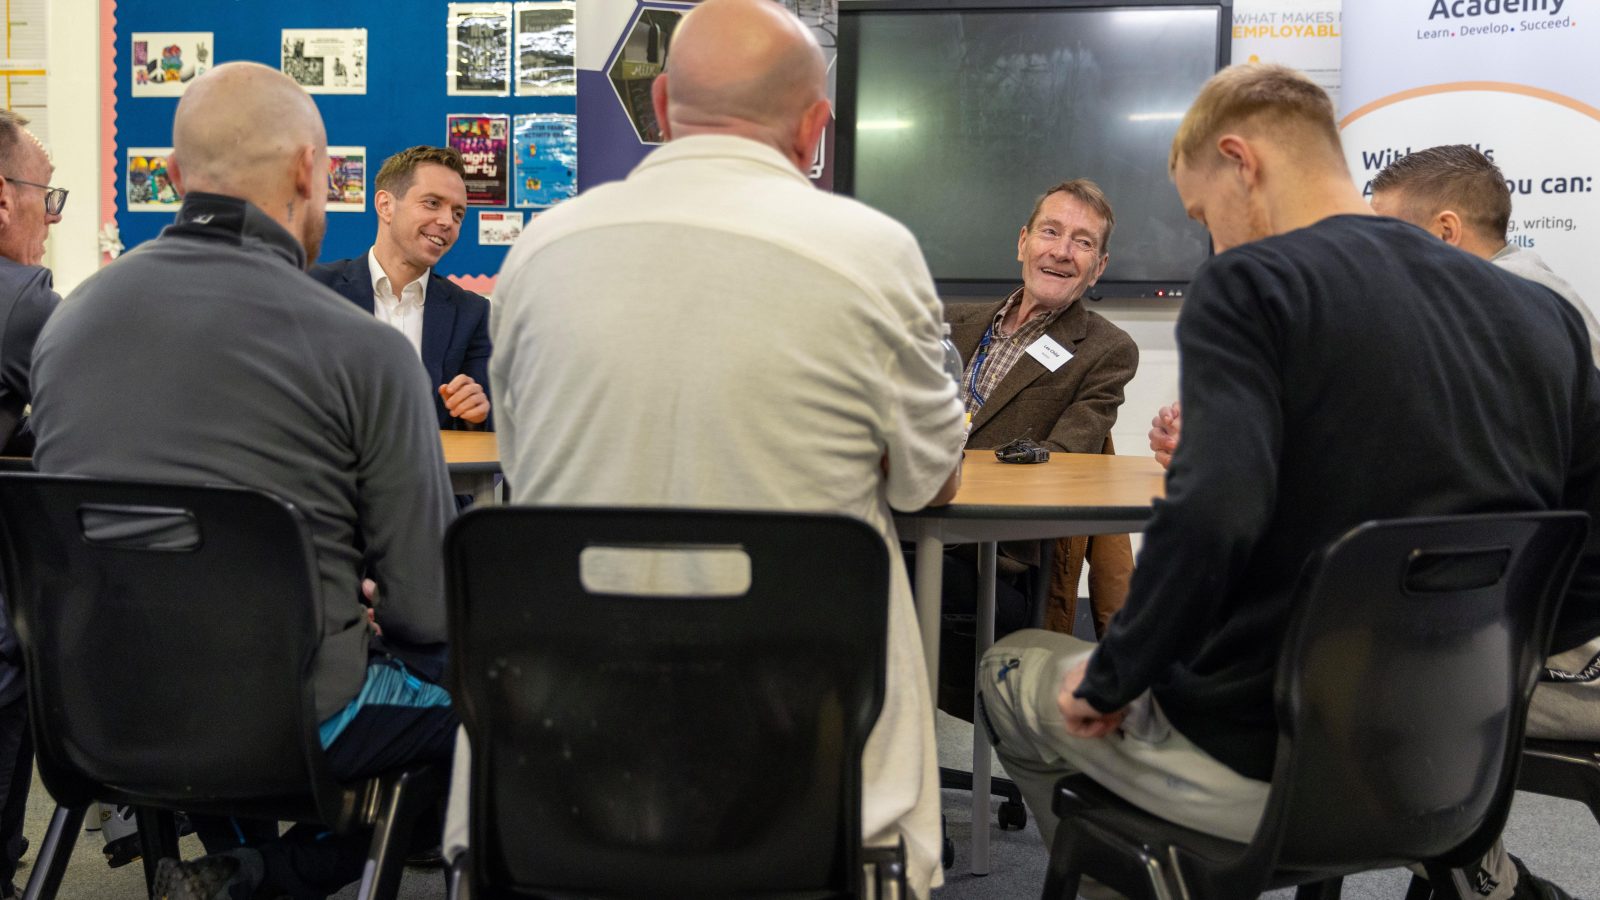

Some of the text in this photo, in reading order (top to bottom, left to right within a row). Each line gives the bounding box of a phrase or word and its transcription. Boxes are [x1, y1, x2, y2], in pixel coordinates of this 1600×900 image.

[1428, 0, 1565, 20] Academy
[1232, 12, 1277, 24] WHAT
[1282, 12, 1334, 23] MAKES
[1232, 24, 1341, 38] EMPLOYABL
[463, 163, 498, 177] arty
[1505, 176, 1592, 195] ou can:
[1523, 216, 1577, 232] writing,
